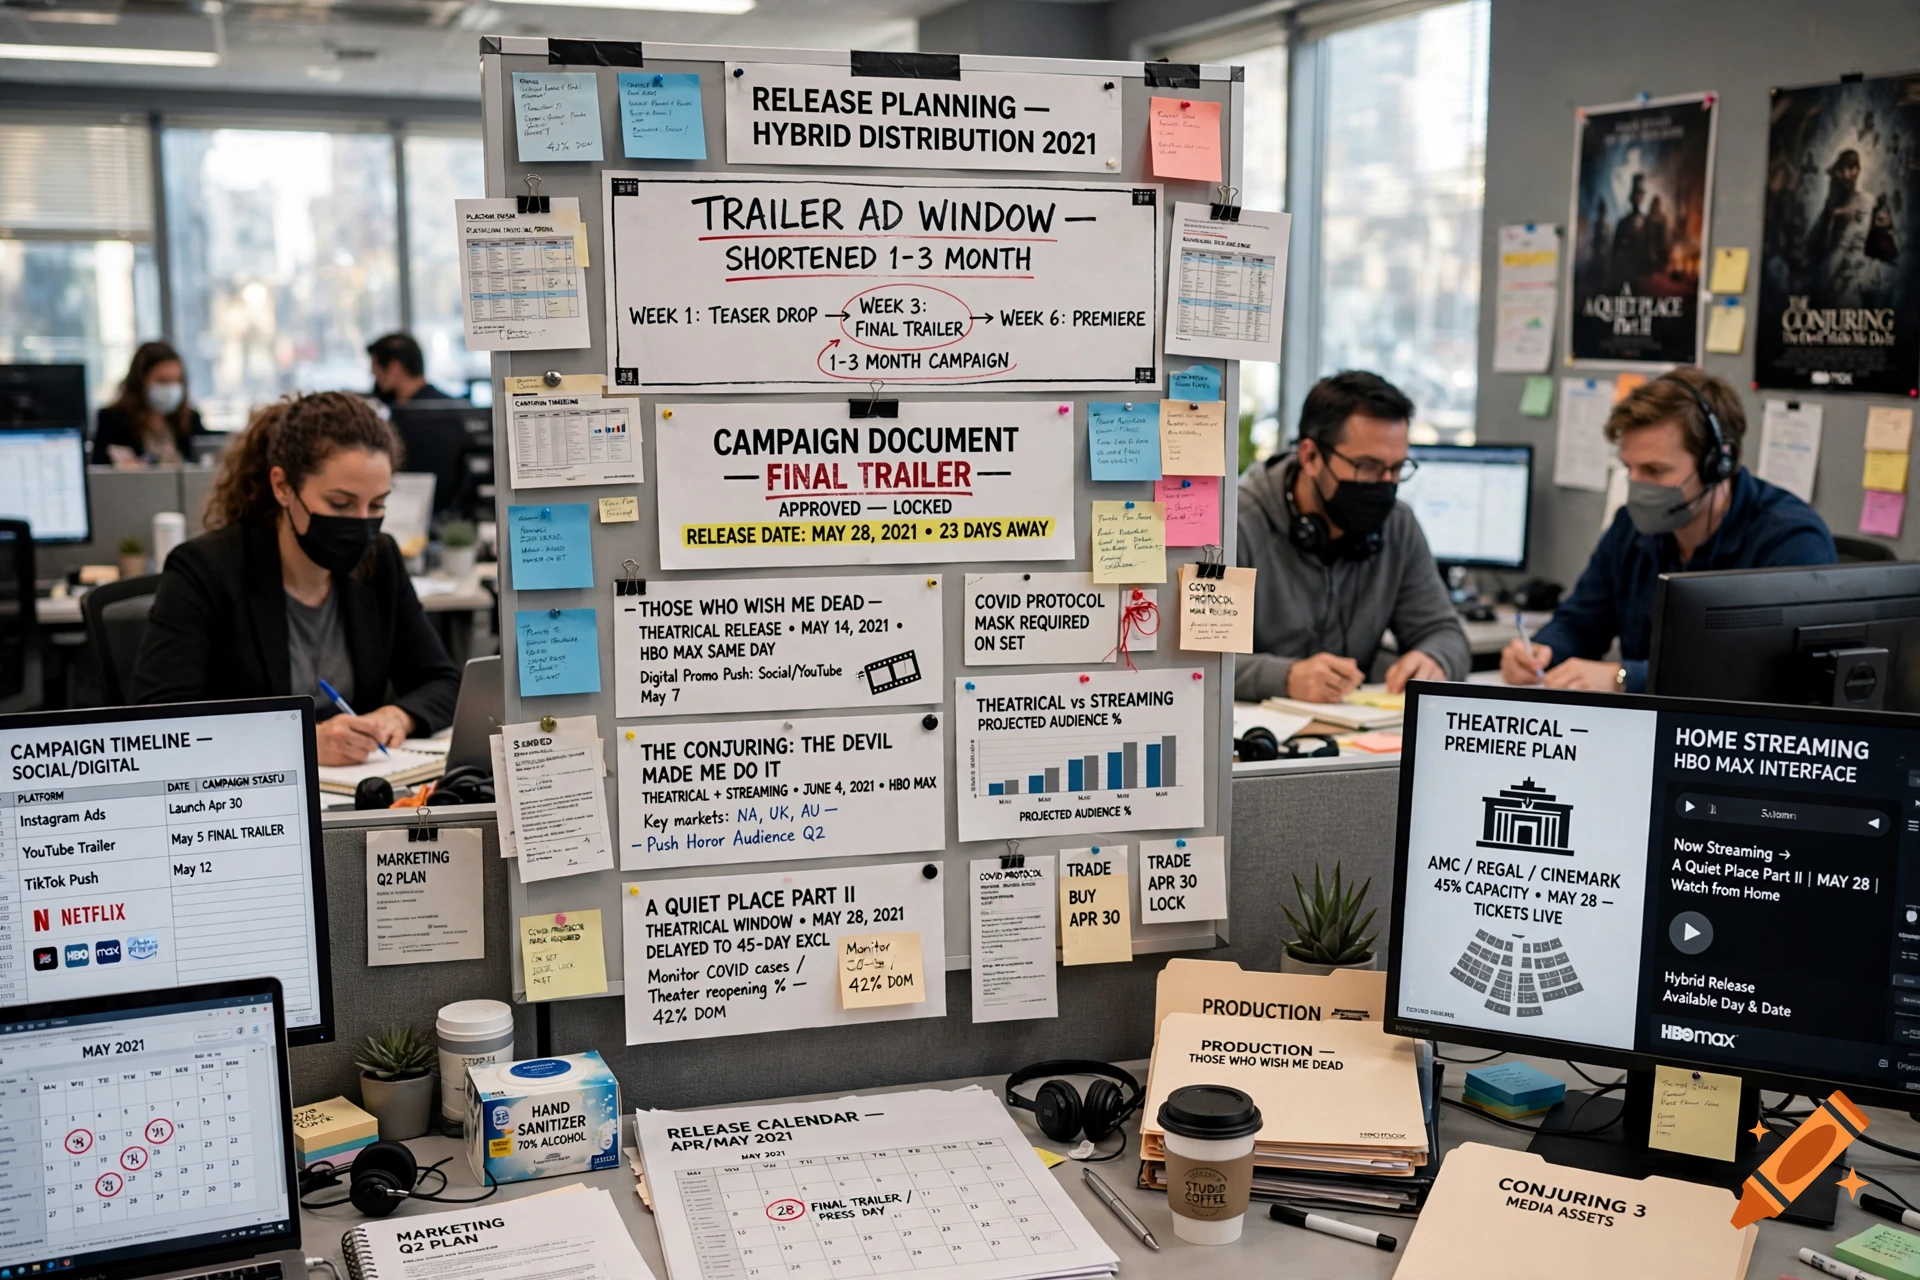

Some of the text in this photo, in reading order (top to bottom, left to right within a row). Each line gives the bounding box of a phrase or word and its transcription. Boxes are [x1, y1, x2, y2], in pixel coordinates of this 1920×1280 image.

[753, 87, 1016, 119] RELEASE PLANNING
[754, 121, 1095, 155] HYBRID DISTRIBUTION 2021
[691, 195, 1056, 233] TRAILER AD WINDOW
[726, 245, 1030, 271] SHORTENED 1-3 MONTH
[629, 306, 818, 325] WEEK 1: TEASER DROP
[860, 297, 926, 314] WEEK 3:
[1000, 309, 1146, 326] WEEK 6: PREMIERE
[856, 320, 963, 337] FINAL TRAILER
[830, 352, 1009, 371] 1-3 MONTH CAMPAIGN
[714, 427, 1019, 456] CAMPAIGN DOCUMENT
[767, 461, 971, 491] FINAL TRAILER
[779, 499, 952, 517] APPROVED LOCKED
[687, 520, 1049, 544] RELEASE DATE: MAY 28, 2021 23 DAYS AWAY
[639, 595, 864, 617] THOSE WHO WISH ME DEAD
[975, 593, 1105, 609] COVID PROTOCOL
[975, 615, 1089, 632] MASK REQUIRED
[641, 642, 775, 660] HBO MAX SAME DAY
[975, 636, 1025, 651] ON SET
[641, 664, 842, 688] Digital Promo Push: Social/YouTube
[976, 691, 1173, 712] THEATRICAL vs STREAMING
[978, 713, 1108, 731] PROJECTED AUDIENCE
[1446, 712, 1563, 737] THEATRICAL
[11, 732, 190, 760] CAMPAIGN TIMELINE
[641, 733, 892, 761] THE CONJURING: THE DEVIL
[1445, 735, 1576, 761] PREMIERE PLAN
[1676, 728, 1869, 759] HOME STREAMING
[13, 757, 139, 780] SOCIAL/DIGITAL
[1674, 753, 1857, 783] HBO MAX INTERFACE
[168, 782, 189, 792] DATE
[202, 777, 249, 789] CAMPAIGN
[18, 791, 64, 803] PLATFORM
[169, 797, 242, 814] Launch Apr 30
[20, 808, 106, 827] Instagram Ads
[22, 839, 115, 859] YouTube Trailer
[648, 826, 825, 853] Push Horor Audience Q2
[1674, 838, 1773, 861] Now Streaming
[377, 851, 449, 866] MARKETING
[1147, 853, 1191, 869] TRADE
[24, 871, 98, 890] TikTok Push
[377, 871, 426, 886] Q2 PLAN
[1148, 874, 1197, 891] APR 30
[1428, 856, 1621, 889] AMC REGAL CINEMARK
[1150, 895, 1185, 911] LOCK
[62, 903, 125, 926] NETFLIX
[1474, 902, 1562, 925] TICKETS LIVE
[67, 949, 88, 961] HBO
[647, 933, 830, 959] DELAYED TO 45-DAY EXCL
[846, 941, 890, 955] Monitor
[648, 963, 789, 984] Monitor COVID cases
[849, 973, 913, 993] 42% DOM
[1665, 971, 1755, 993] Hybrid Release
[648, 981, 767, 1004] Theater reopening
[83, 1039, 144, 1058] MAY 2021
[1202, 1040, 1312, 1056] PRODUCTION
[532, 1102, 570, 1118] HAND
[518, 1115, 586, 1135] SANITIZER
[667, 1112, 859, 1139] RELEASE CALENDAR
[518, 1132, 586, 1150] 70% ALCOHOL
[671, 1132, 792, 1151] APR/MAY 2021
[811, 1194, 902, 1212] FINAL TRAILER
[1499, 1178, 1646, 1217] CONJURING 3
[777, 1205, 795, 1216] 28
[819, 1206, 884, 1220] PRESS DAY
[1506, 1196, 1615, 1227] MEDIA ASSETS
